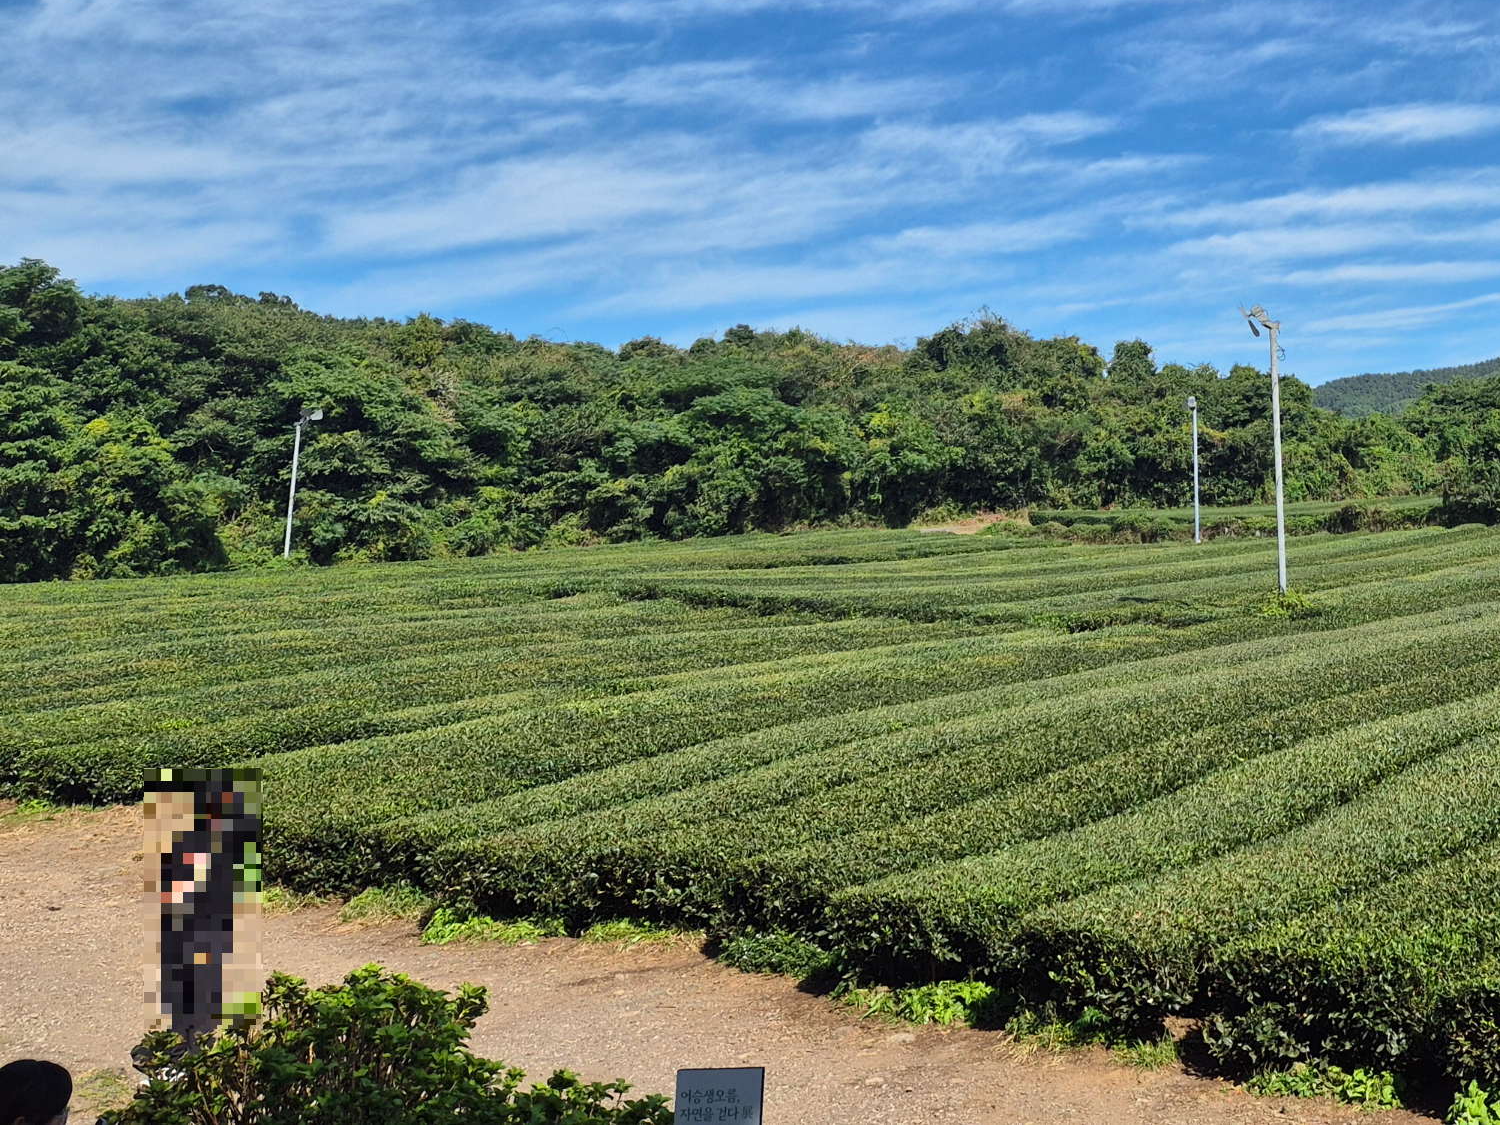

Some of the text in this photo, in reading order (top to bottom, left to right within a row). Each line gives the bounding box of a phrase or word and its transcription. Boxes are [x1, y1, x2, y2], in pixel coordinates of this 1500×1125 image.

[680, 1088, 741, 1104] 어승생오름,
[680, 1105, 754, 1122] 자연을 걷다 展
